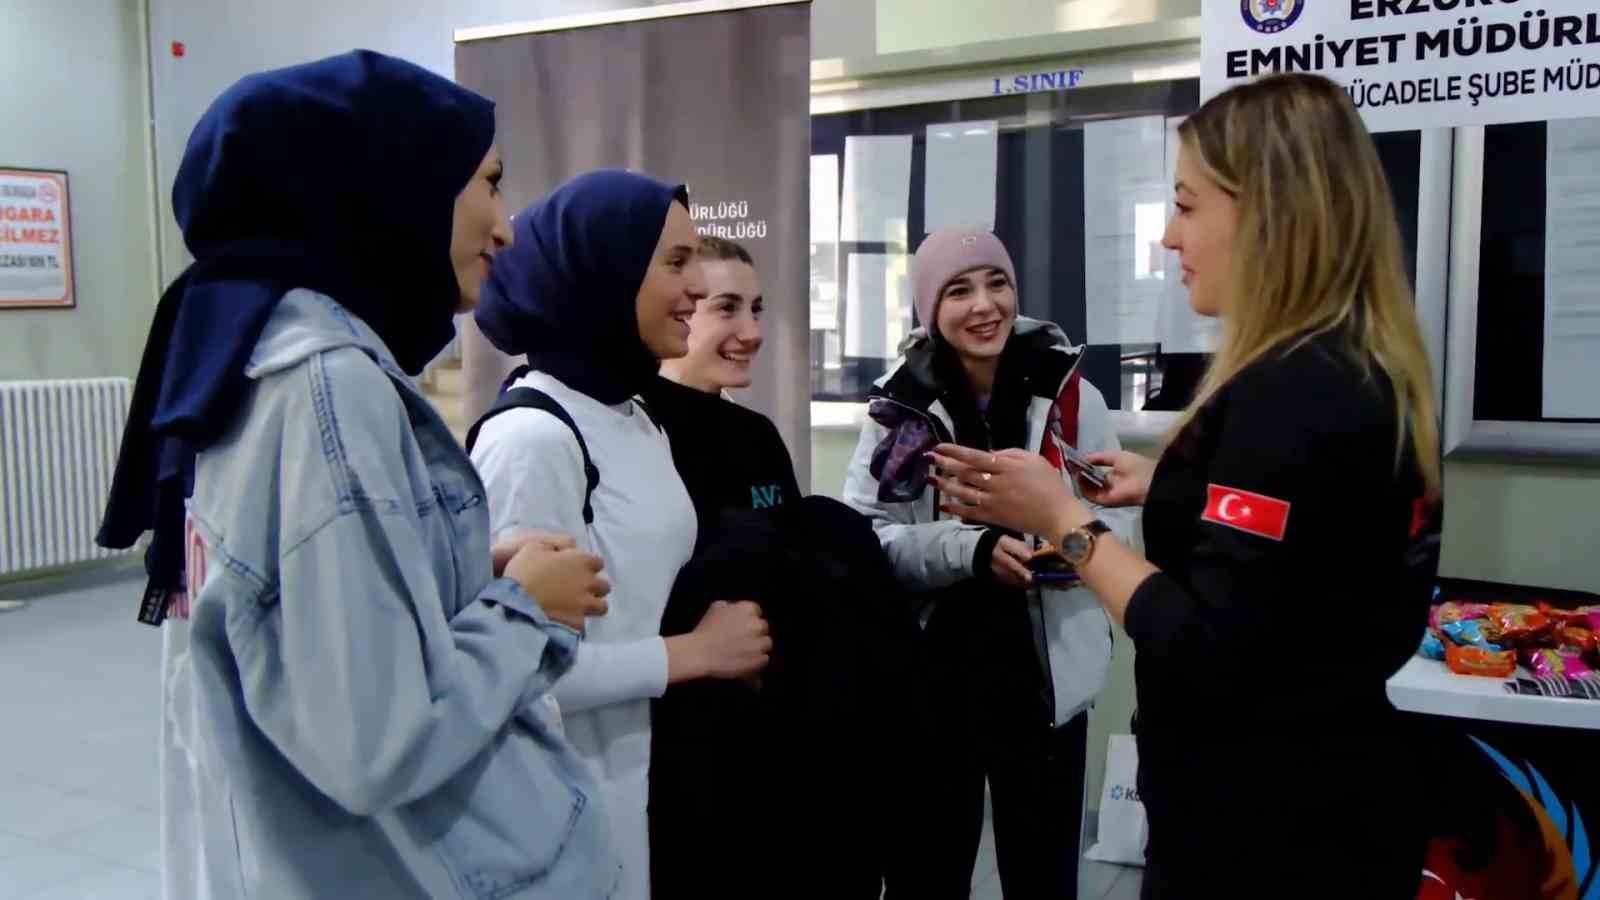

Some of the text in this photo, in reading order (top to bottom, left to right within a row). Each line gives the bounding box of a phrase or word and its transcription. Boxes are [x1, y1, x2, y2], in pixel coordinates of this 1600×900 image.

[1226, 9, 1600, 78] EMNİYET MÜDÜRL
[1344, 75, 1461, 108] ÜCADELE
[1468, 69, 1536, 106] ŞUBE
